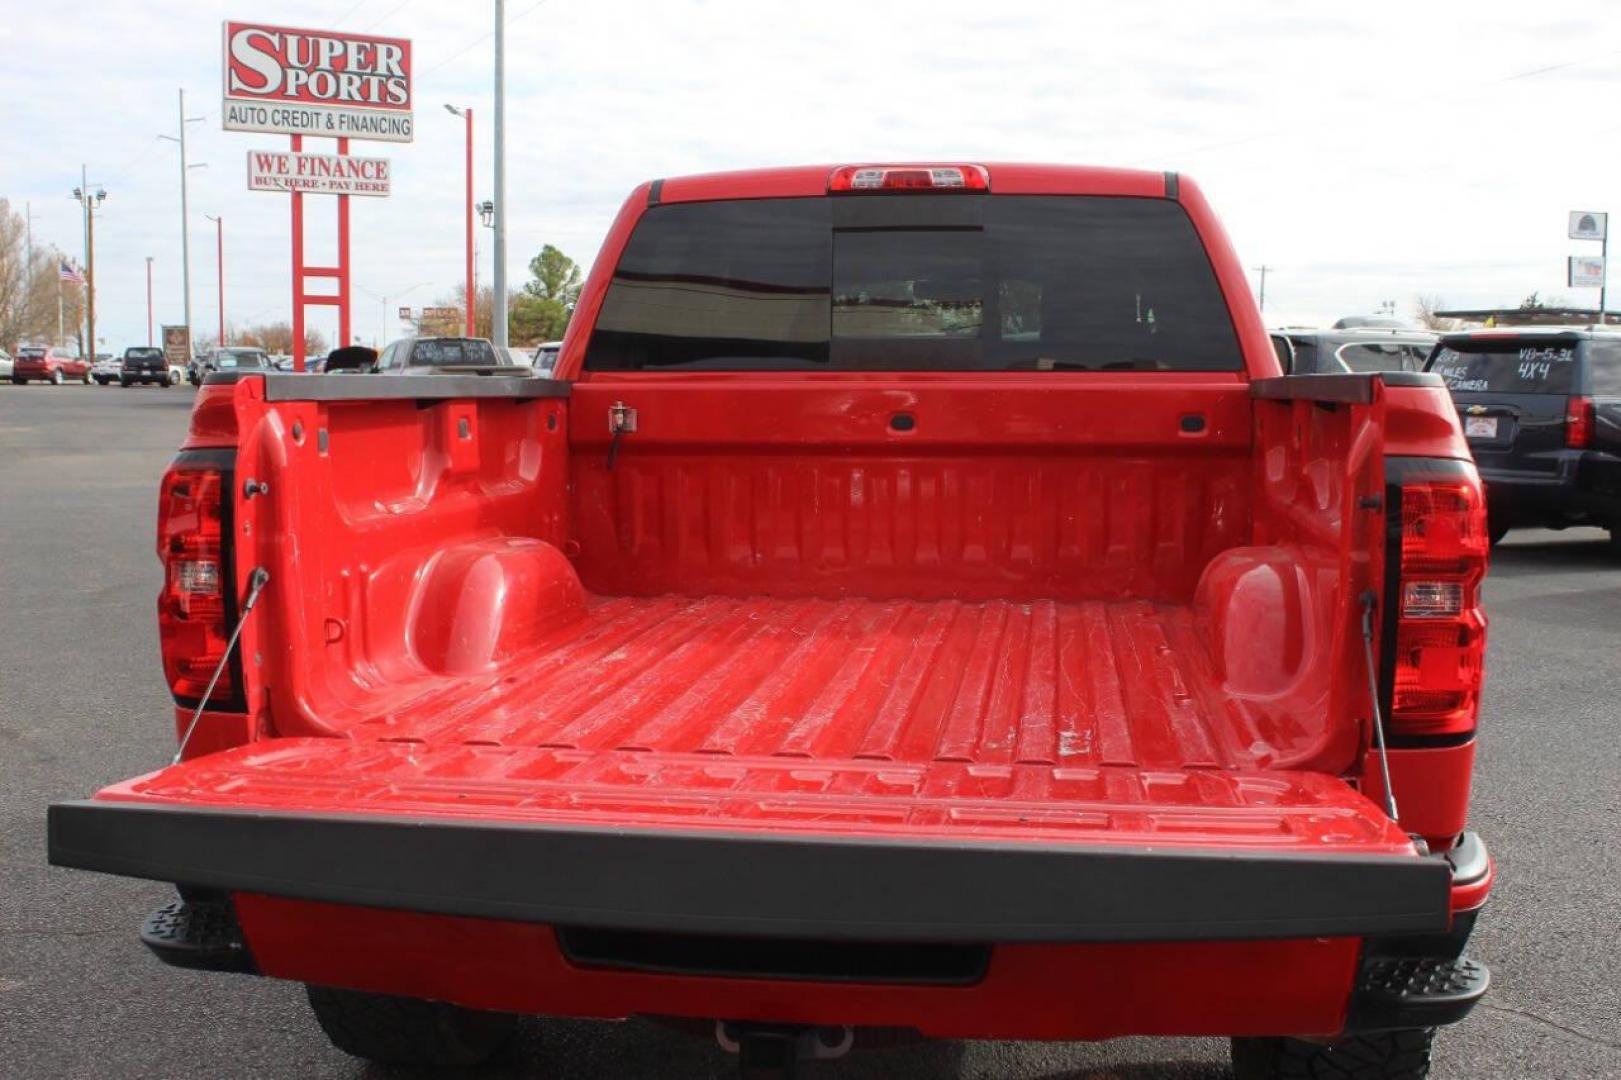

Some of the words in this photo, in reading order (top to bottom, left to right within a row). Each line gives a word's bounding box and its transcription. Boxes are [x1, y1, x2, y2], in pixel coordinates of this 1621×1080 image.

[231, 28, 406, 95] SUPER
[228, 106, 268, 125] AUTO
[271, 108, 321, 129] CREDIT
[325, 114, 335, 130] &
[339, 114, 410, 135] FINANCING
[256, 153, 289, 175] WE
[298, 155, 388, 180] FINANCE
[255, 176, 281, 187] BUY
[284, 178, 320, 188] HERE
[328, 180, 351, 190] PAY
[355, 183, 389, 192] HERE
